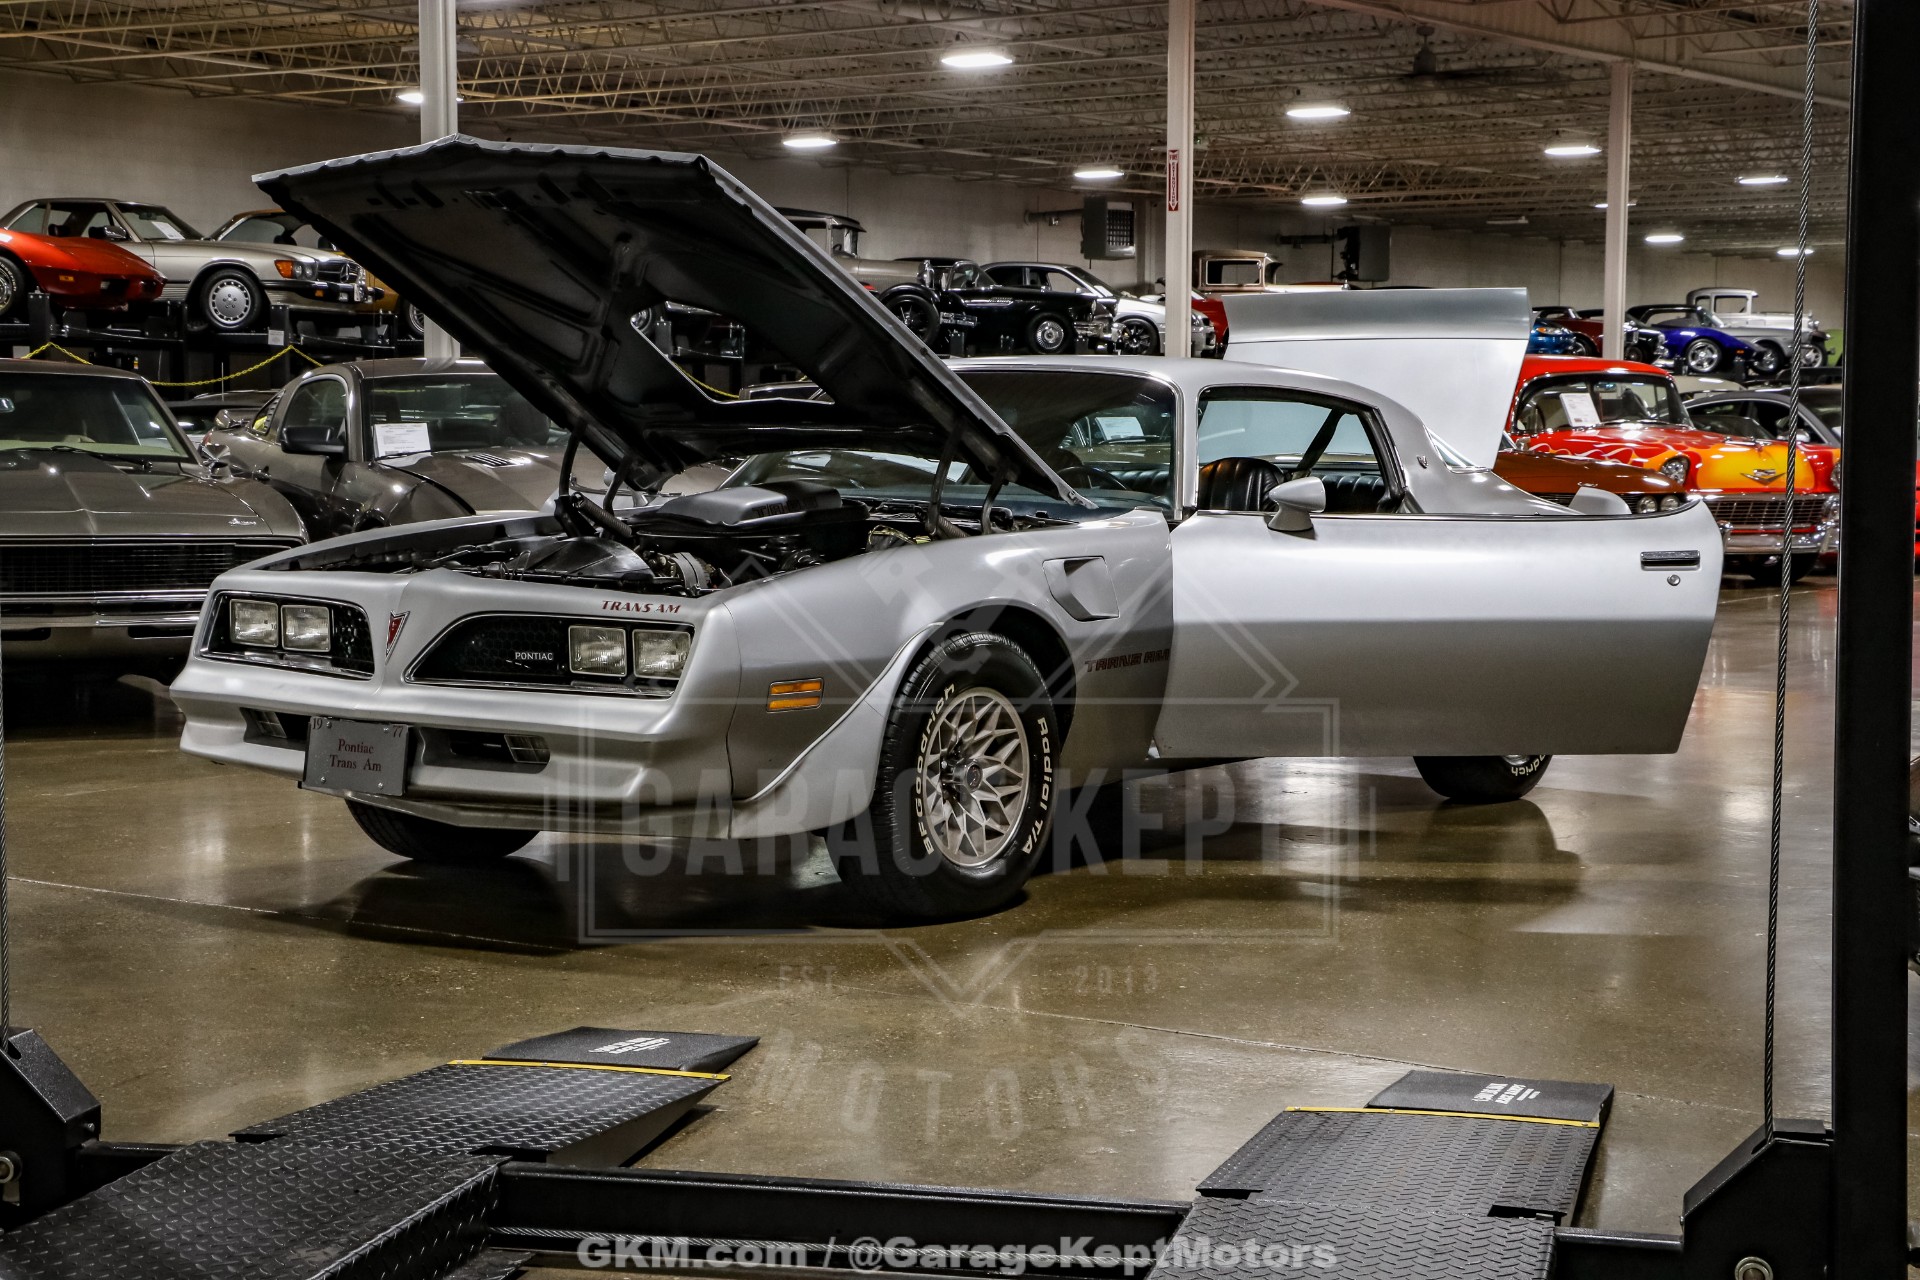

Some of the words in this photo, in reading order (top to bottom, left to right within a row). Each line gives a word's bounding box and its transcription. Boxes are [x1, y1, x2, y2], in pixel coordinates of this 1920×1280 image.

[601, 600, 653, 613] TRANS
[654, 603, 682, 614] AM
[514, 651, 554, 661] PONTIAC
[1085, 652, 1142, 673] TRANS
[312, 717, 323, 730] 19
[392, 725, 404, 738] 77
[338, 738, 375, 754] Pontiac
[329, 754, 357, 770] Trans
[363, 757, 382, 772] Am
[1037, 717, 1053, 811] Radial
[1022, 819, 1043, 855] T/A
